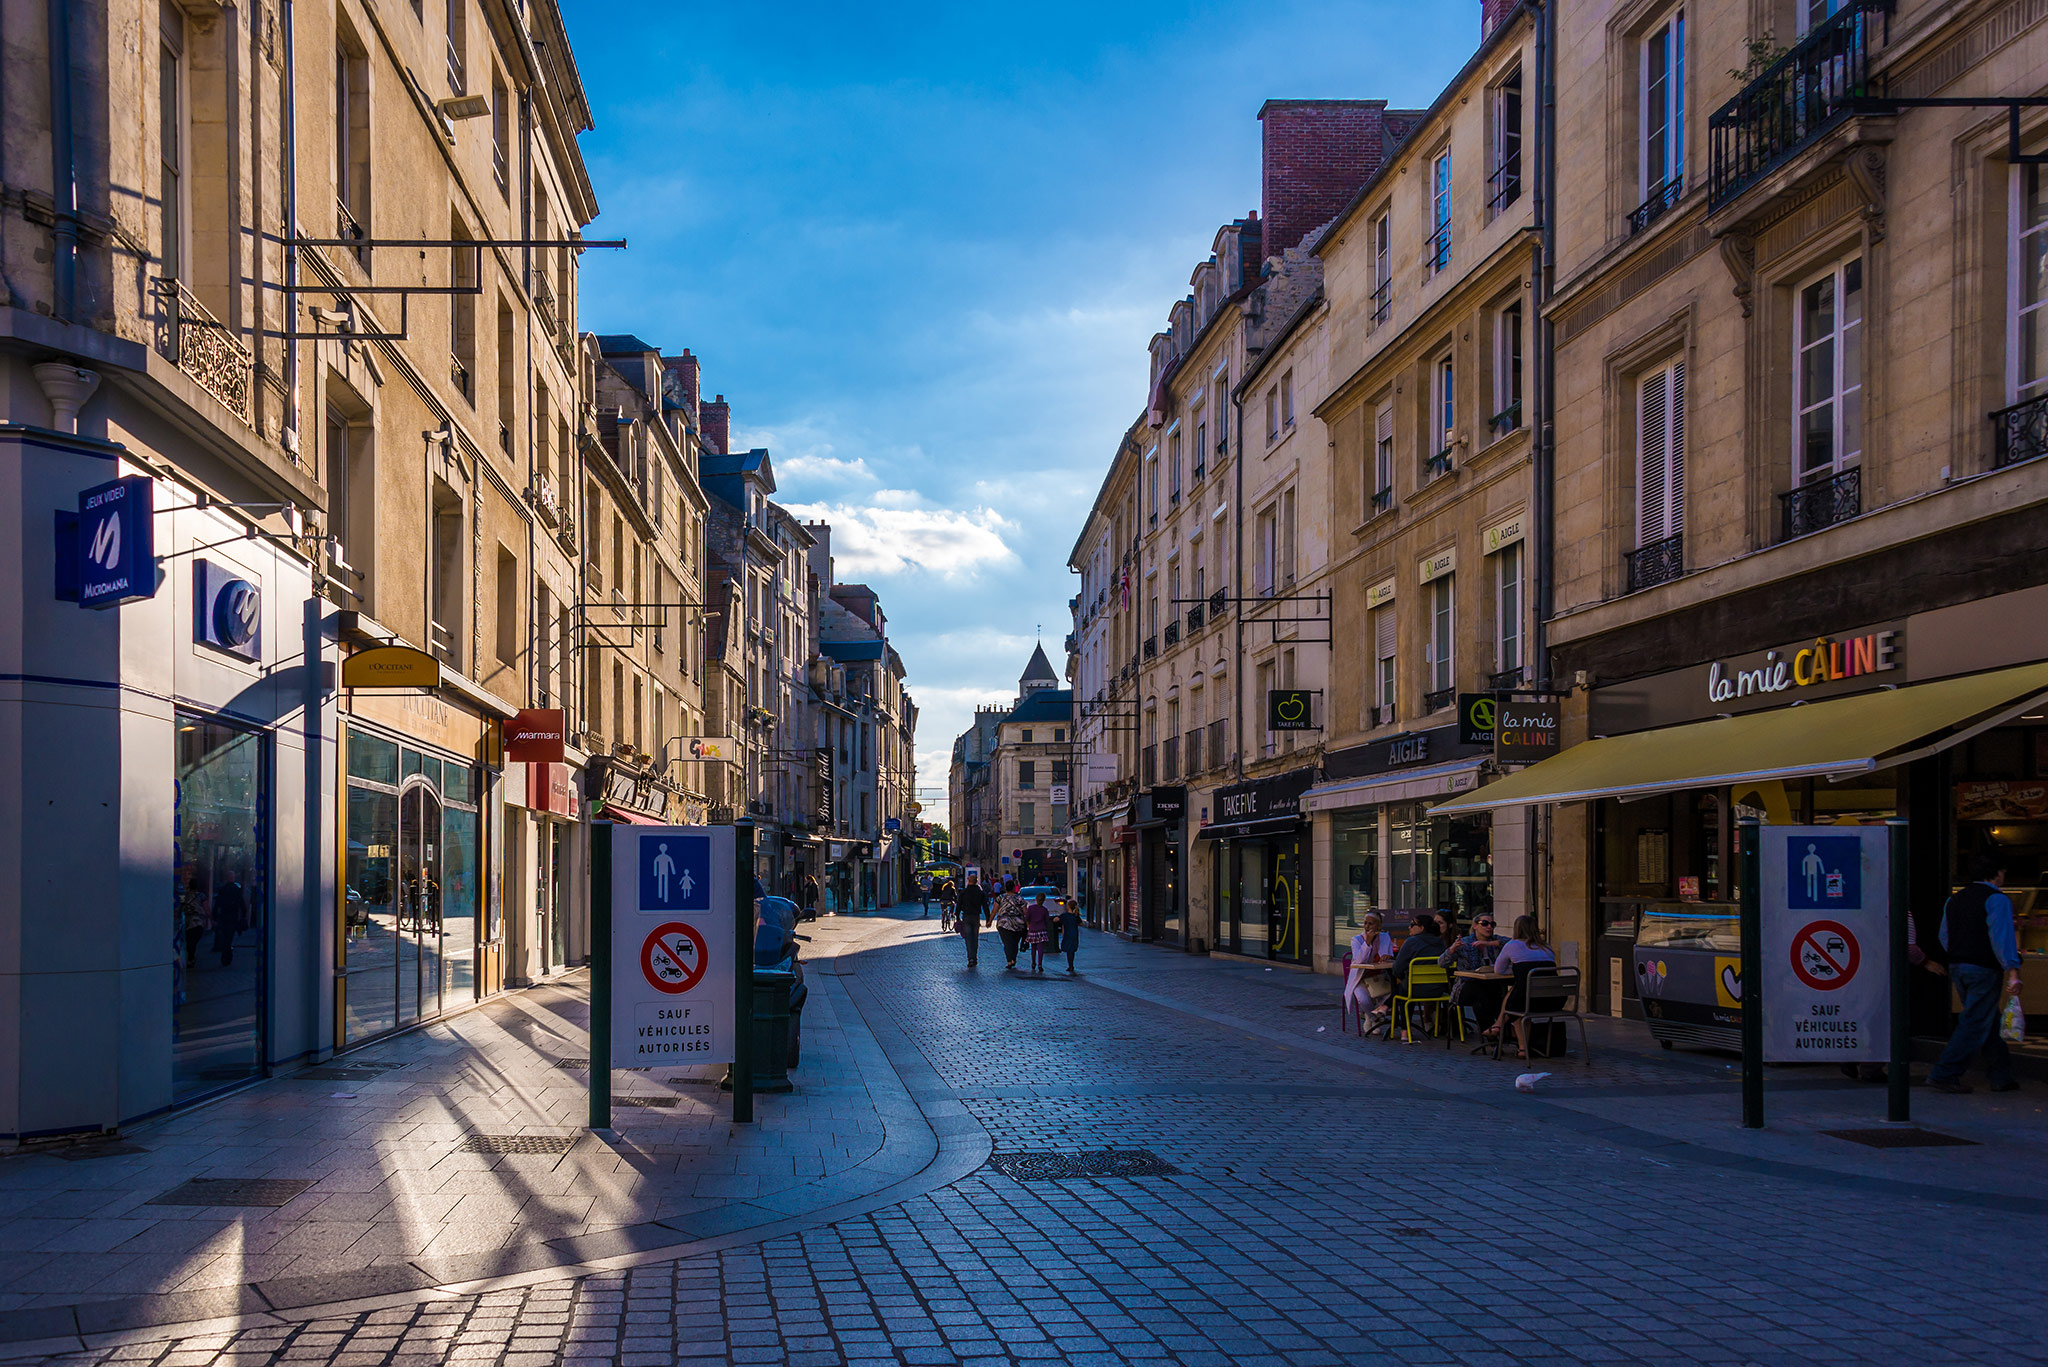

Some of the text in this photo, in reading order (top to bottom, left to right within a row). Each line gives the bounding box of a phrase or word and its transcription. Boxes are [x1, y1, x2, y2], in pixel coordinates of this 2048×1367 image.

[86, 486, 125, 510] JEUX VIDEO
[1500, 523, 1520, 541] AIGLE
[1433, 556, 1450, 572] AIGLE
[84, 577, 129, 599] MICROMANIA
[1378, 585, 1391, 598] AIGLE
[368, 662, 414, 671] L'OCCITANE
[1708, 630, 1896, 703] la mie CÂLINE
[1503, 711, 1556, 729] la mie
[1469, 731, 1495, 741] AIGL
[1388, 737, 1427, 766] AIGLE
[816, 751, 833, 822] Bruce field
[1454, 777, 1468, 788] AIGLE
[1222, 794, 1240, 817] TAKE
[1240, 791, 1257, 814] FIVE
[658, 1009, 691, 1019] SAUF
[1811, 1004, 1841, 1016] SAUF
[638, 1024, 710, 1037] VÉHICULES
[1795, 1019, 1857, 1032] VÉHICULES
[638, 1040, 710, 1054] AUTORISÉS
[1795, 1036, 1858, 1049] AUTORISÉS
